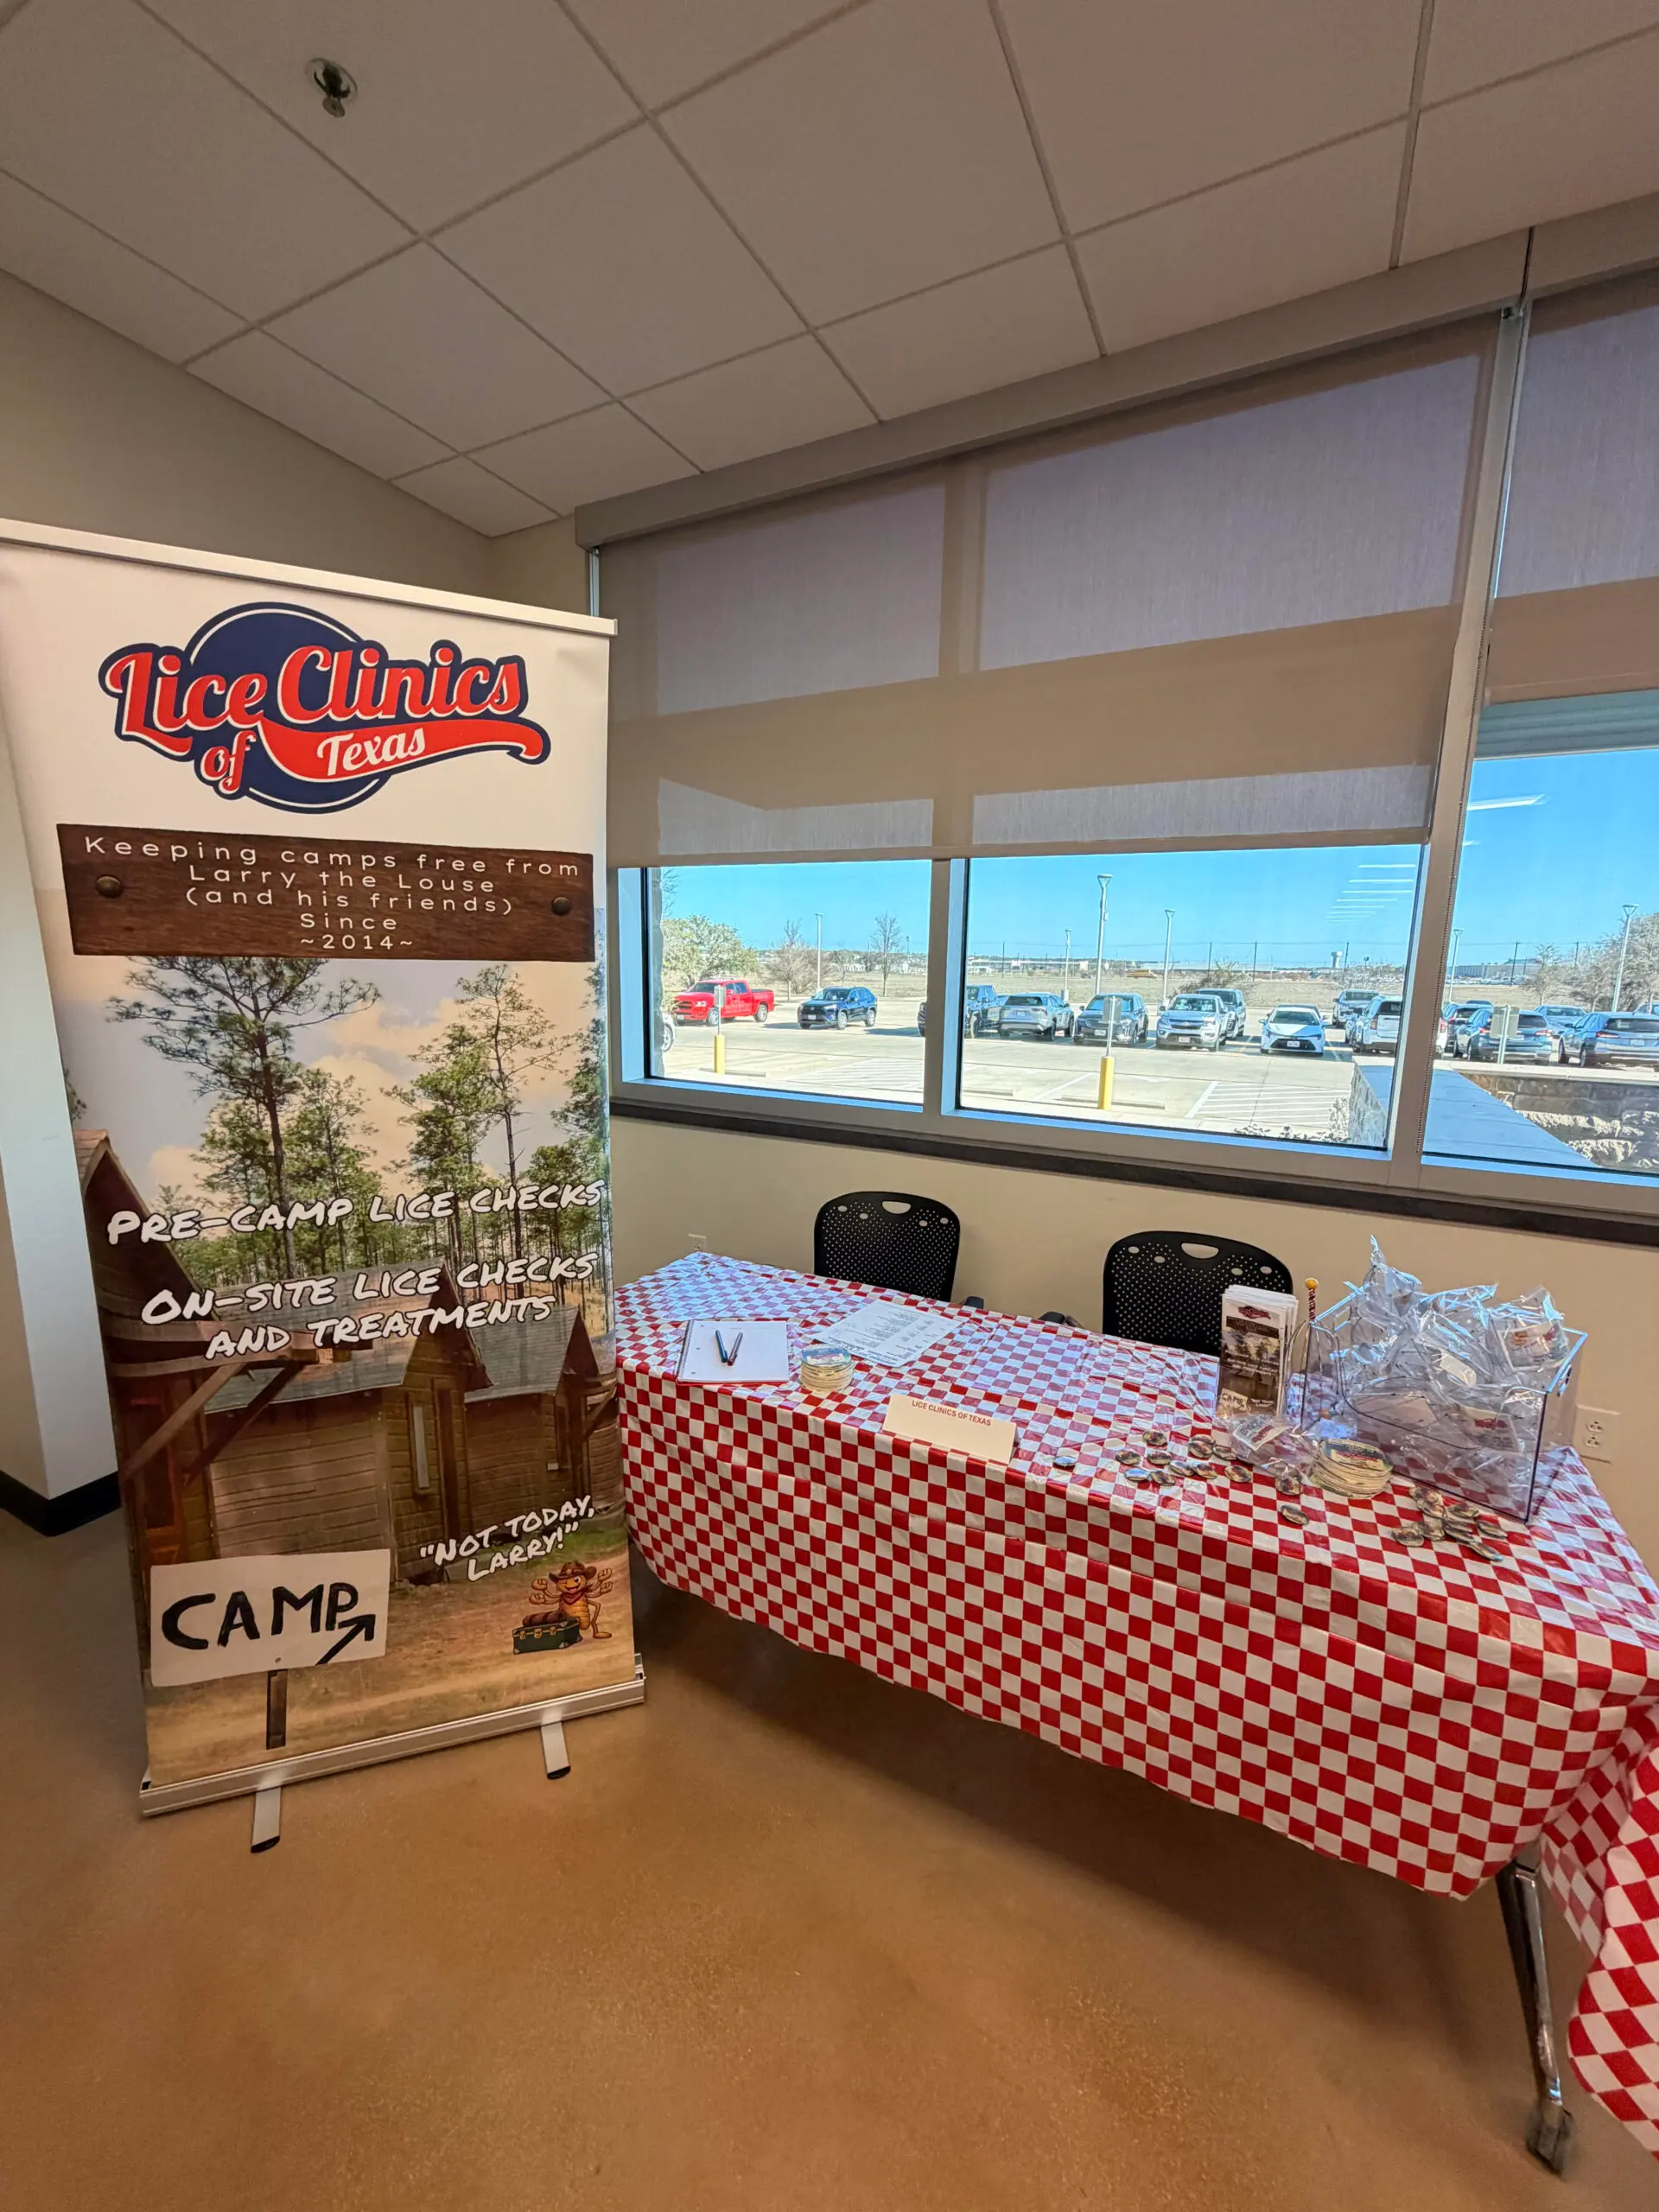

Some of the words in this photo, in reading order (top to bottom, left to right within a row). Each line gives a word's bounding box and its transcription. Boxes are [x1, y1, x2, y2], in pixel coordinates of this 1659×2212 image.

[104, 652, 268, 756] Lice
[276, 645, 520, 722] Clinics
[200, 728, 257, 792] of
[316, 728, 425, 777] Texas
[85, 836, 257, 865] Keeping
[280, 849, 397, 871] camps
[416, 854, 486, 873] free
[506, 859, 579, 877] from
[189, 865, 296, 889] Larry
[319, 870, 377, 888] the
[398, 874, 494, 893] Louse
[186, 887, 273, 906] (and
[297, 890, 349, 908] his
[370, 893, 512, 916] friends)
[300, 912, 397, 931] Since
[300, 933, 413, 950] ~2014~
[107, 1198, 355, 1245] PRE-CAMP
[369, 1191, 456, 1223] LICE
[469, 1179, 606, 1213] CHECKS
[141, 1276, 338, 1325] ON-SITE
[353, 1268, 442, 1300] LICE
[456, 1253, 600, 1288] CHECKS
[205, 1325, 292, 1360] AND
[307, 1295, 557, 1348] TREATMENTS
[912, 1400, 928, 1410] LICE
[928, 1404, 957, 1417] CLINICS
[957, 1411, 968, 1420] OF
[969, 1414, 992, 1427] TEXAS
[504, 1494, 594, 1537] TODAY,
[161, 1582, 359, 1650] CAMP
